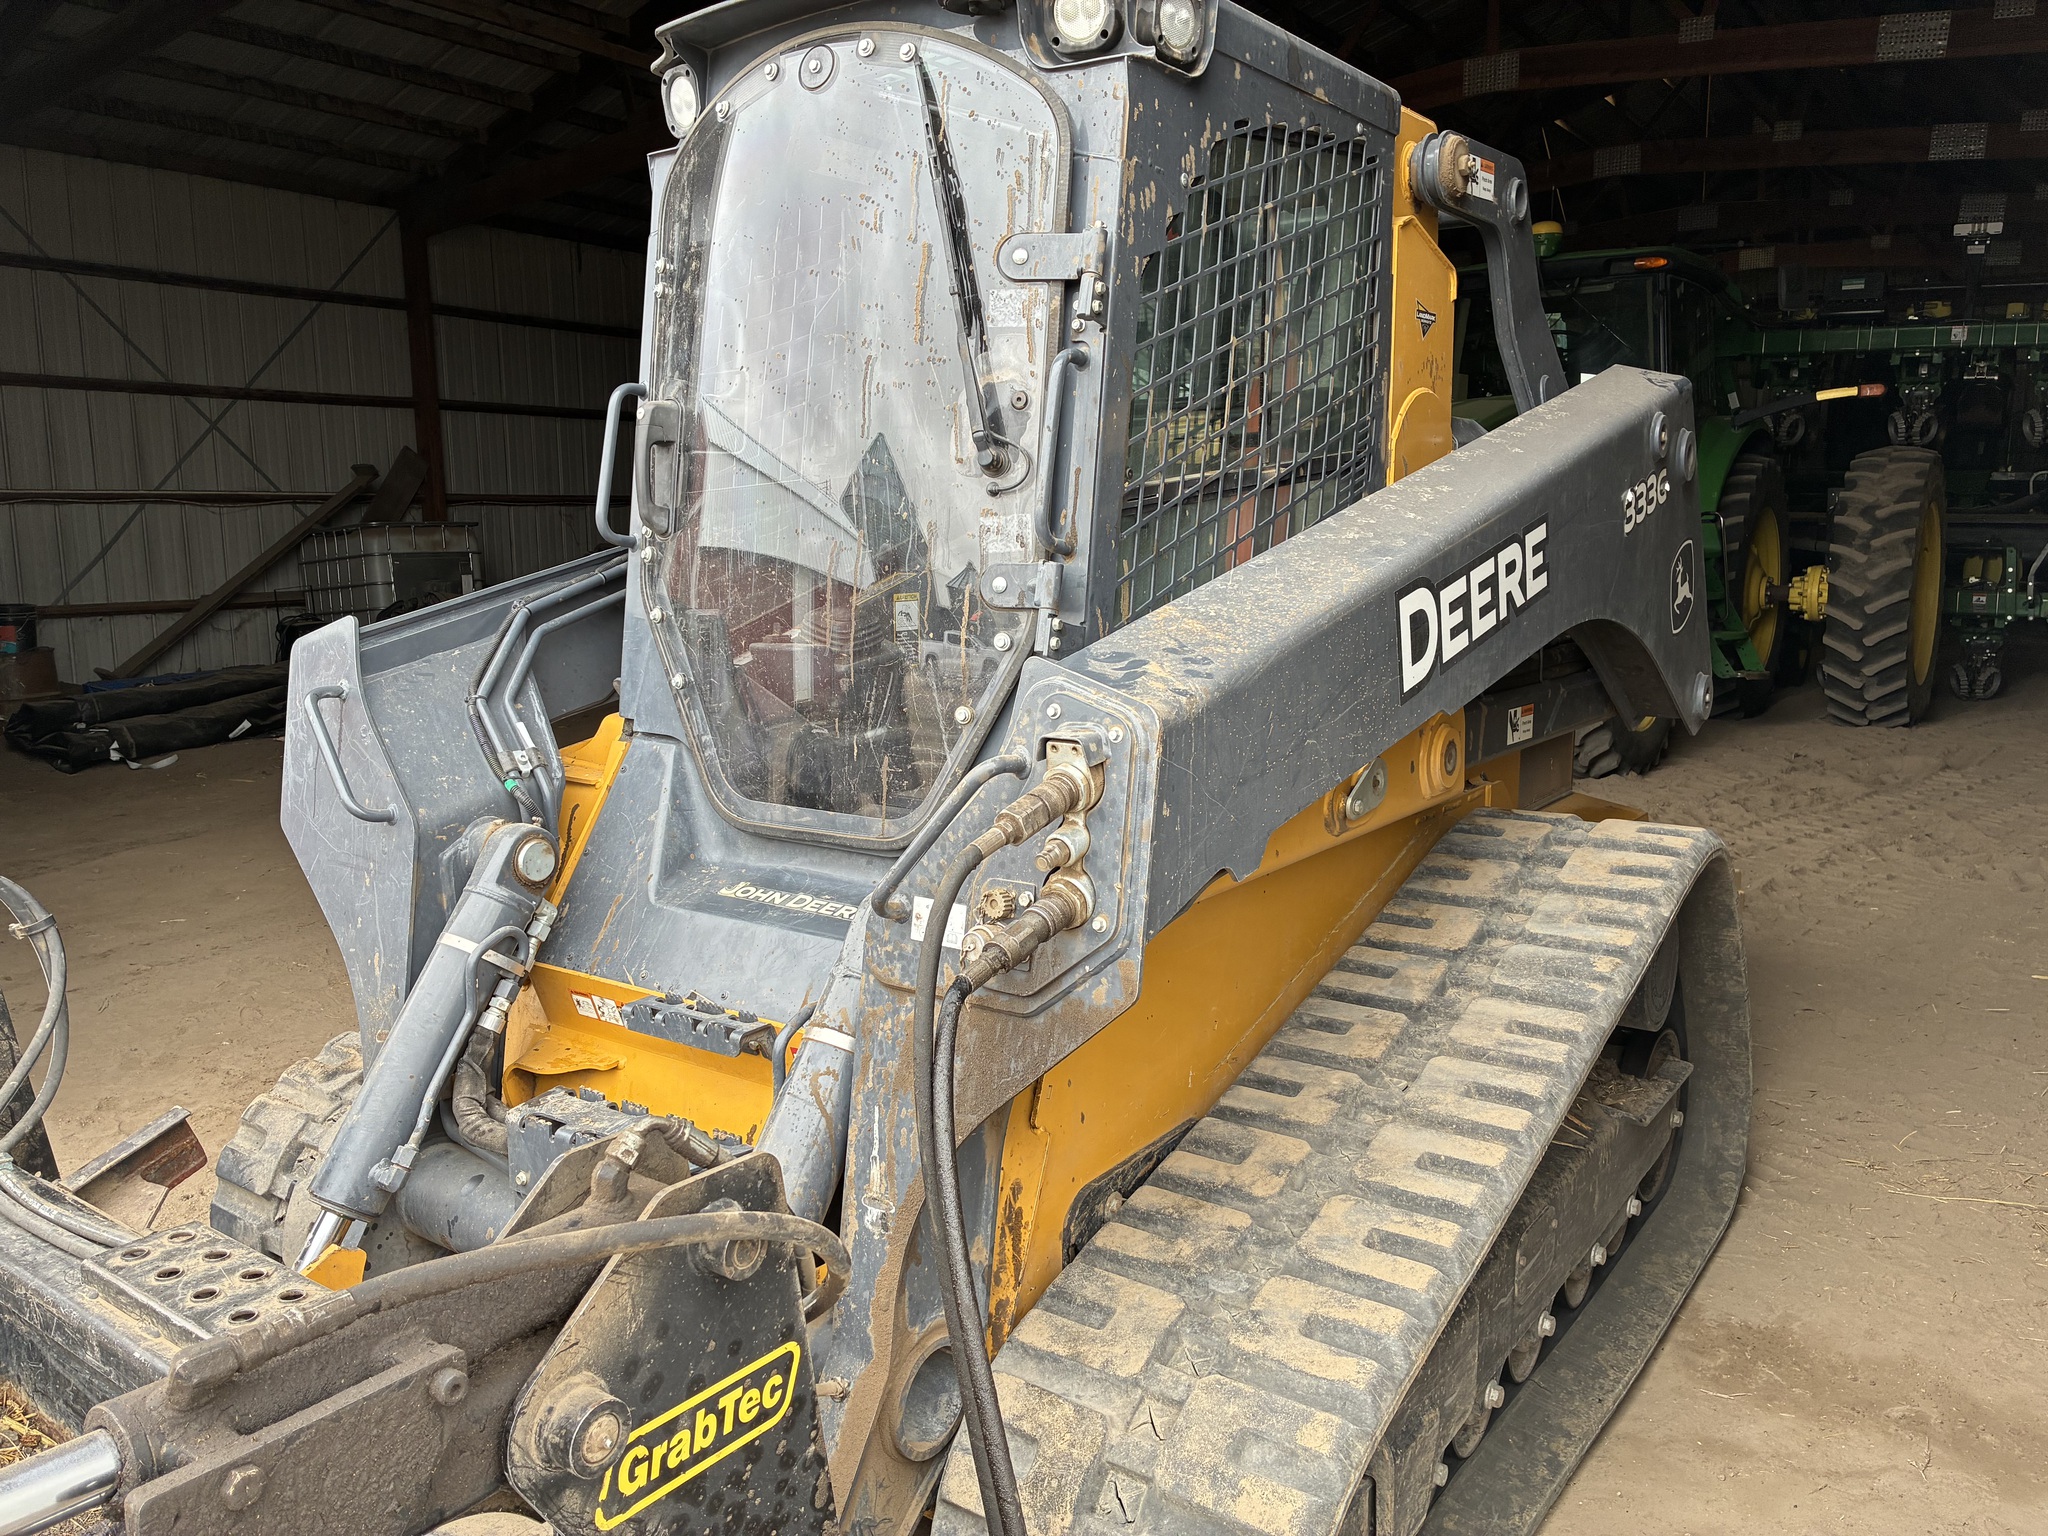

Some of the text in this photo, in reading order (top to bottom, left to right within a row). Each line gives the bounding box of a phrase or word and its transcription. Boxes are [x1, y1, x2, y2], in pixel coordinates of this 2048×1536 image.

[1399, 522, 1548, 693] DEERE
[718, 882, 858, 920] JOHN DEER
[617, 1374, 784, 1497] GrabTec
